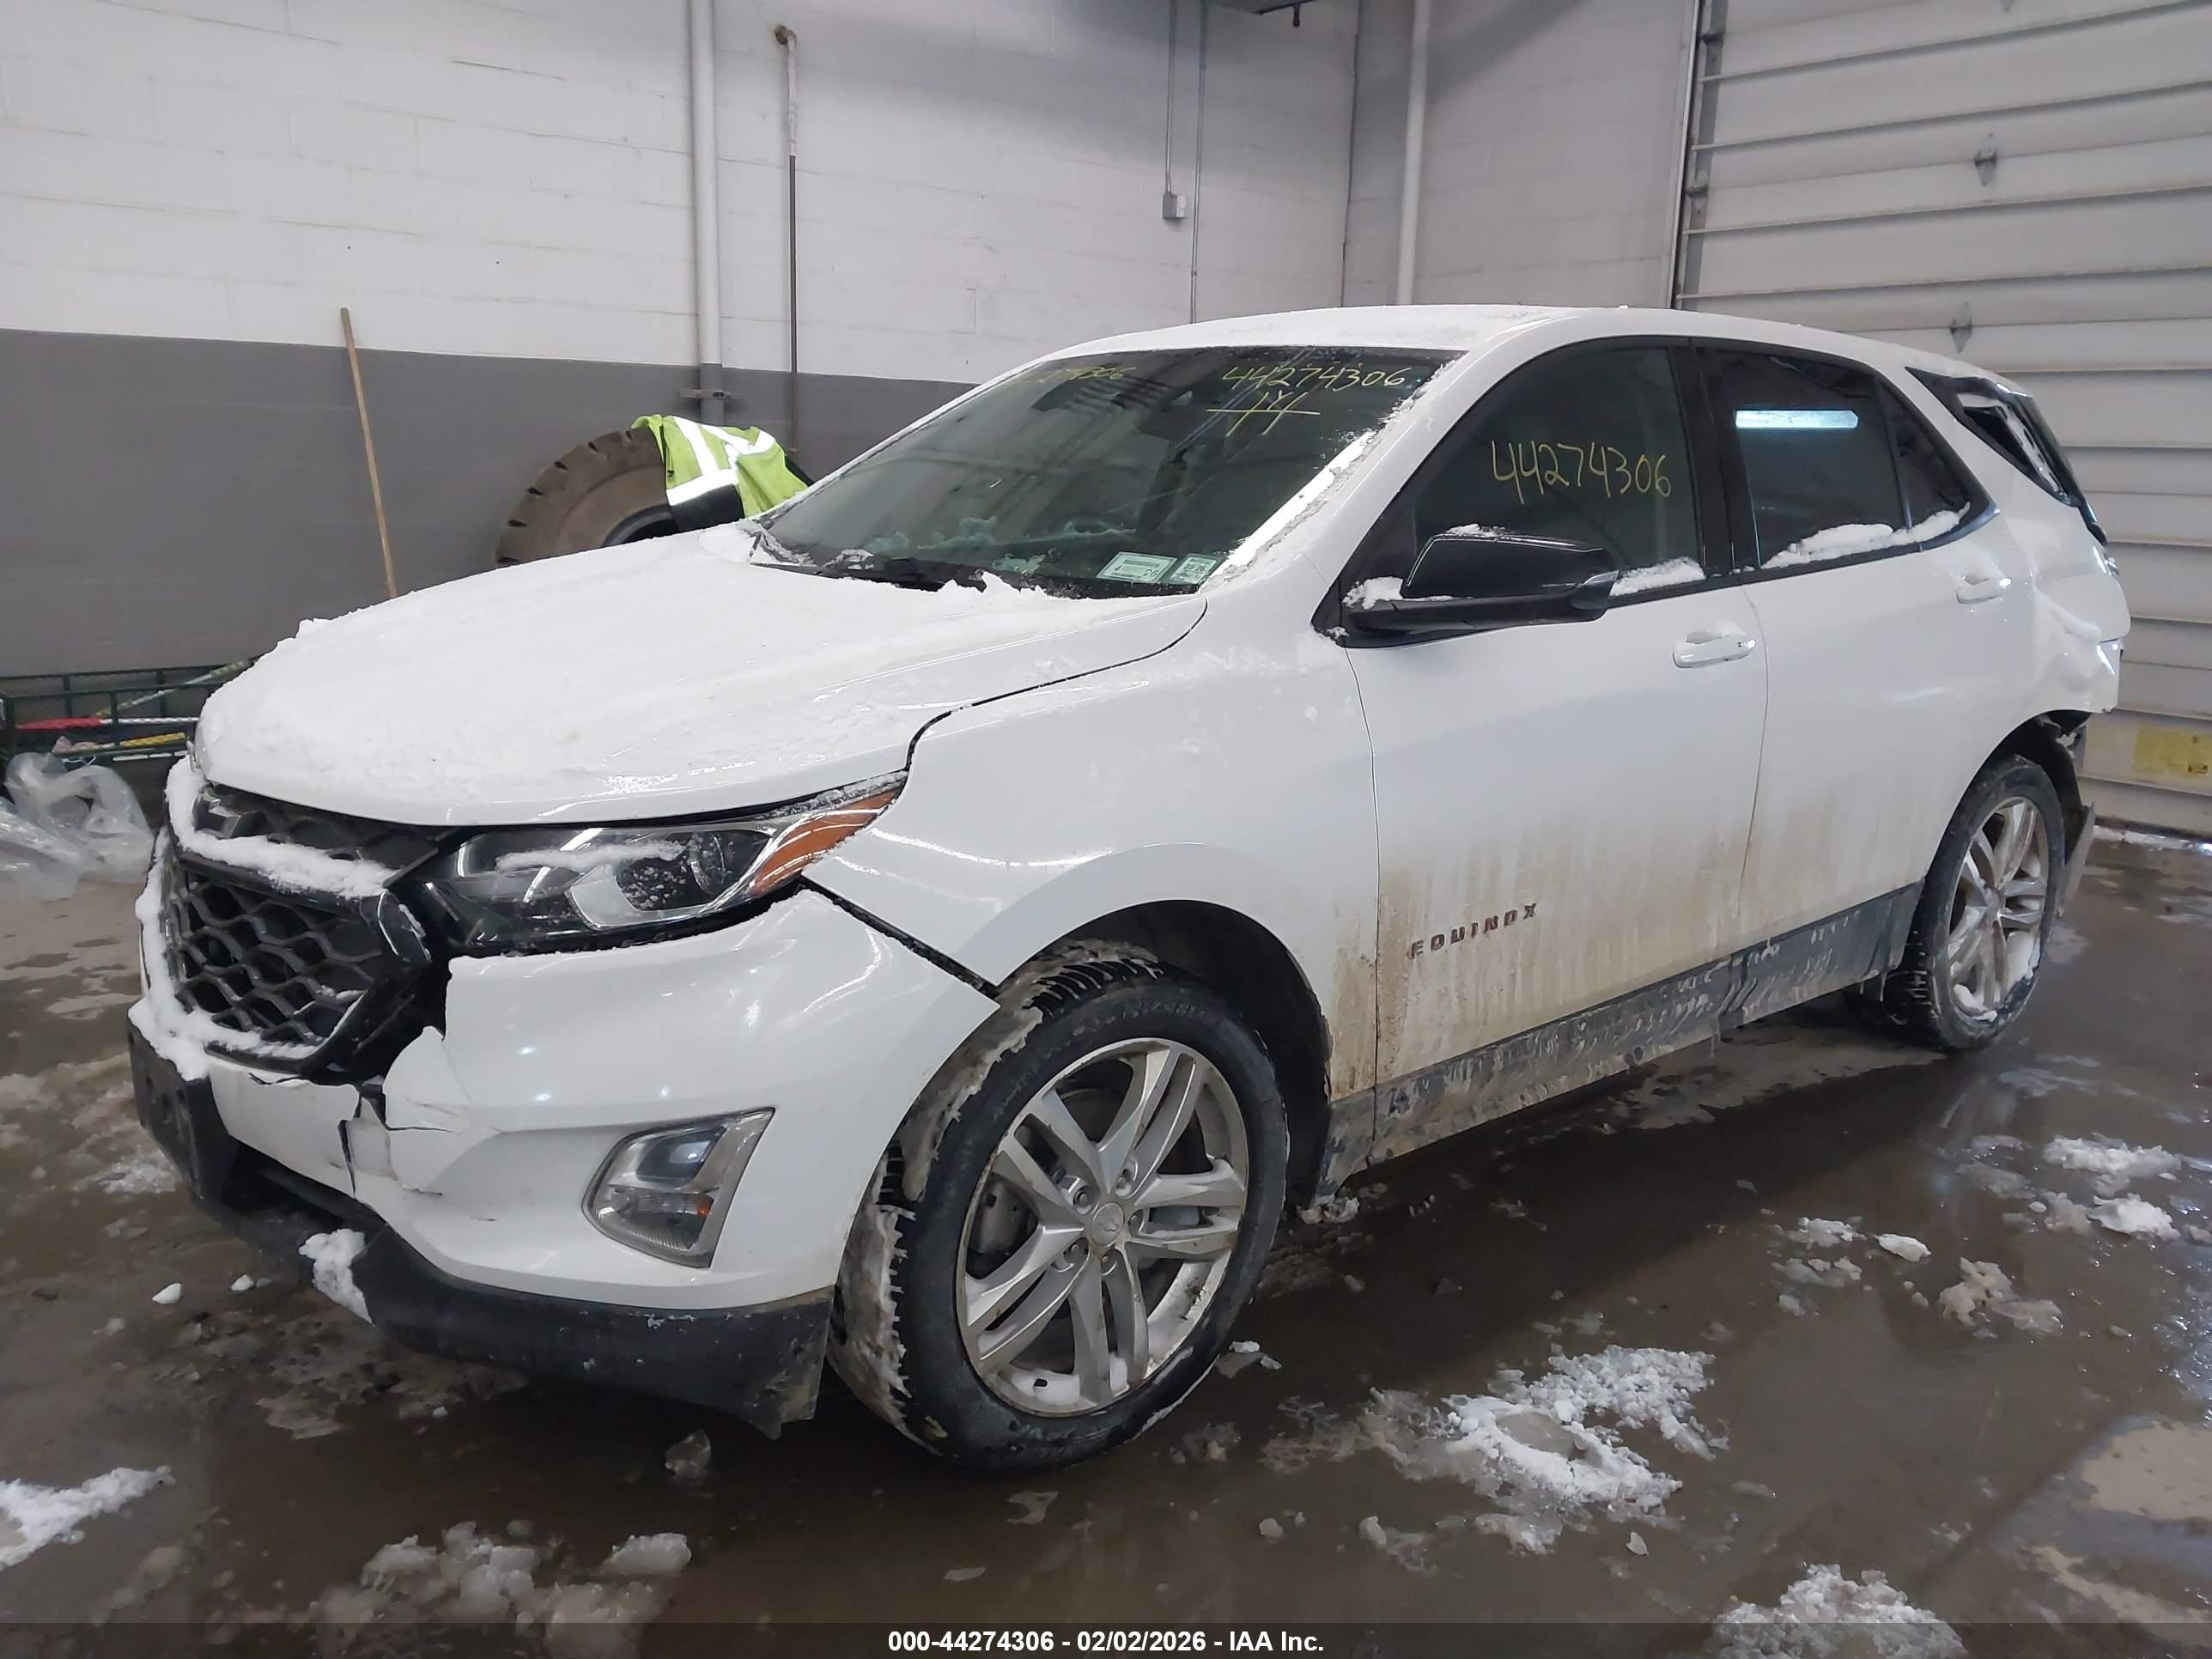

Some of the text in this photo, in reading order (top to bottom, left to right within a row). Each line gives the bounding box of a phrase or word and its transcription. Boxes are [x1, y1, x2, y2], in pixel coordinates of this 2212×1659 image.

[1222, 366, 1413, 392] 44274306
[1491, 440, 1672, 505] 44274306
[1407, 902, 1537, 960] EQUINOX
